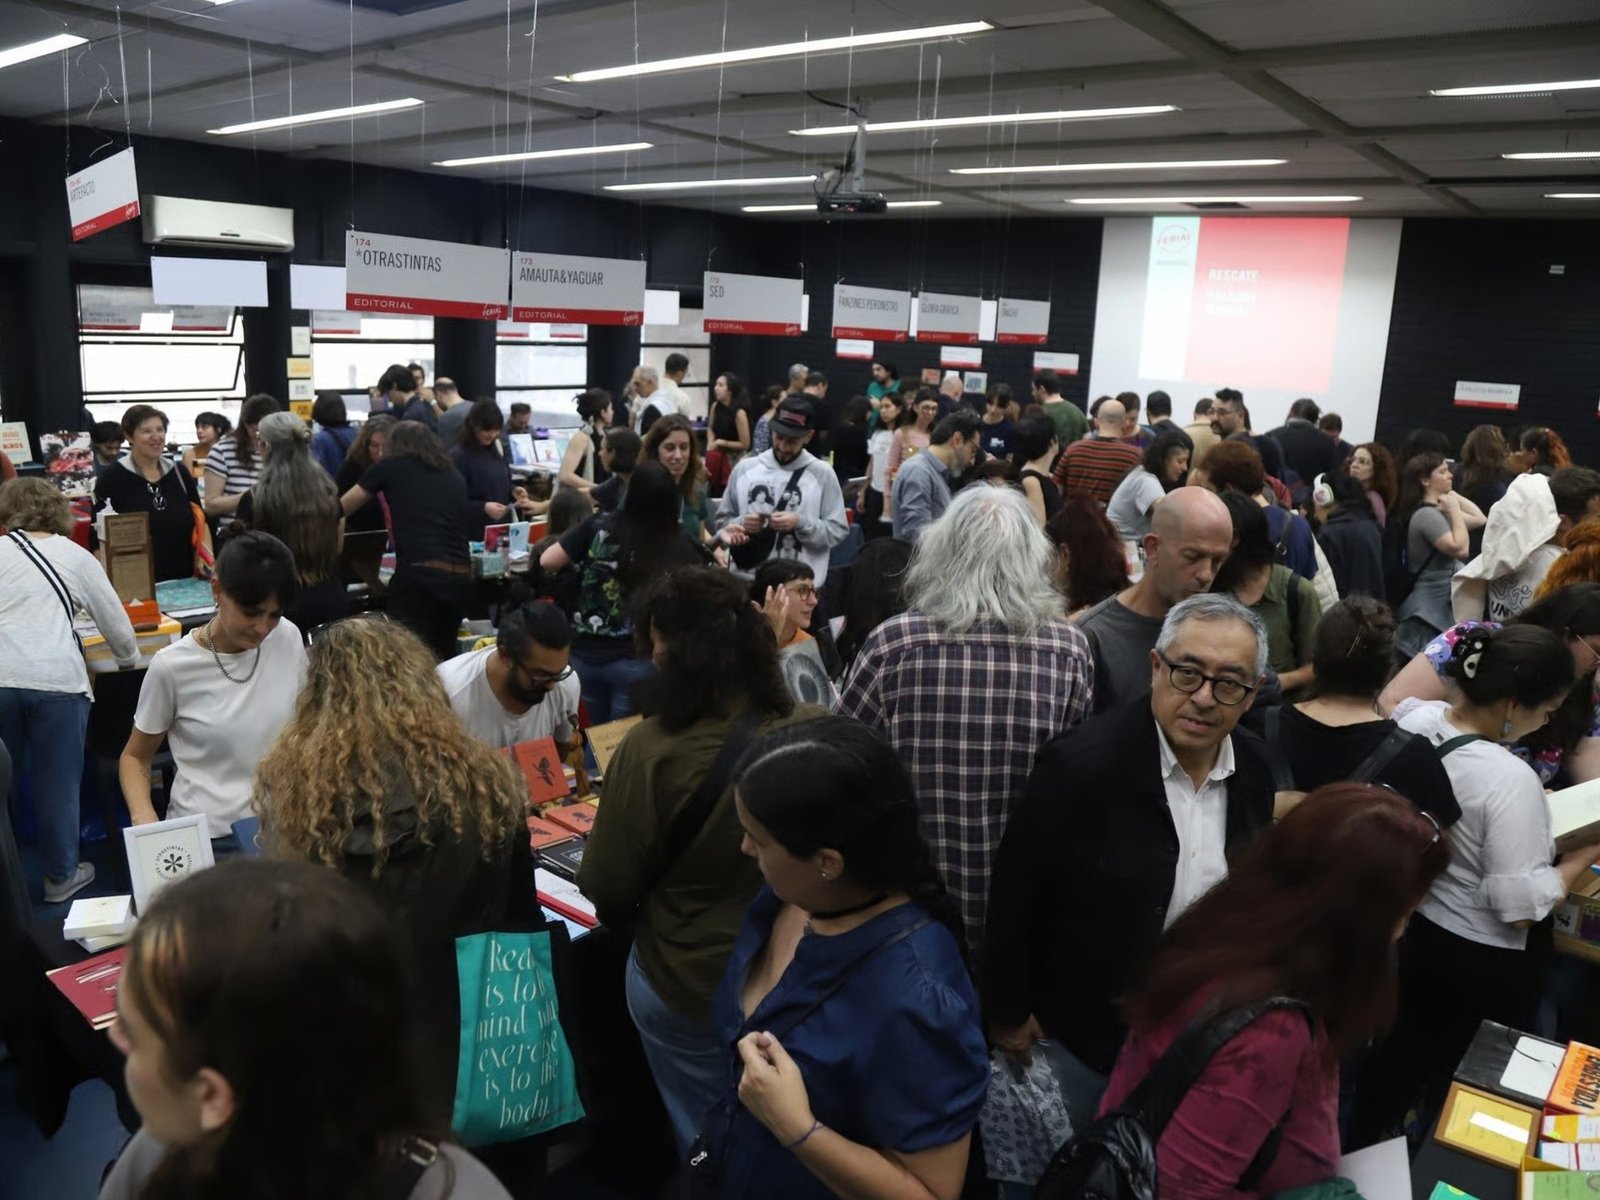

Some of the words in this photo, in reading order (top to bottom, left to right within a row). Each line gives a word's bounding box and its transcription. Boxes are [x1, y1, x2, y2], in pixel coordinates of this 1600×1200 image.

[355, 238, 371, 247] 174
[520, 257, 533, 266] 173
[519, 267, 604, 286] AMAUTA&YAGUAR
[709, 284, 725, 298] SED
[354, 298, 414, 310] EDITORIAL
[519, 310, 568, 320] EDITORIAL
[708, 321, 745, 331] EDITORIAL
[485, 977, 505, 1009] is
[485, 1073, 501, 1100] is
